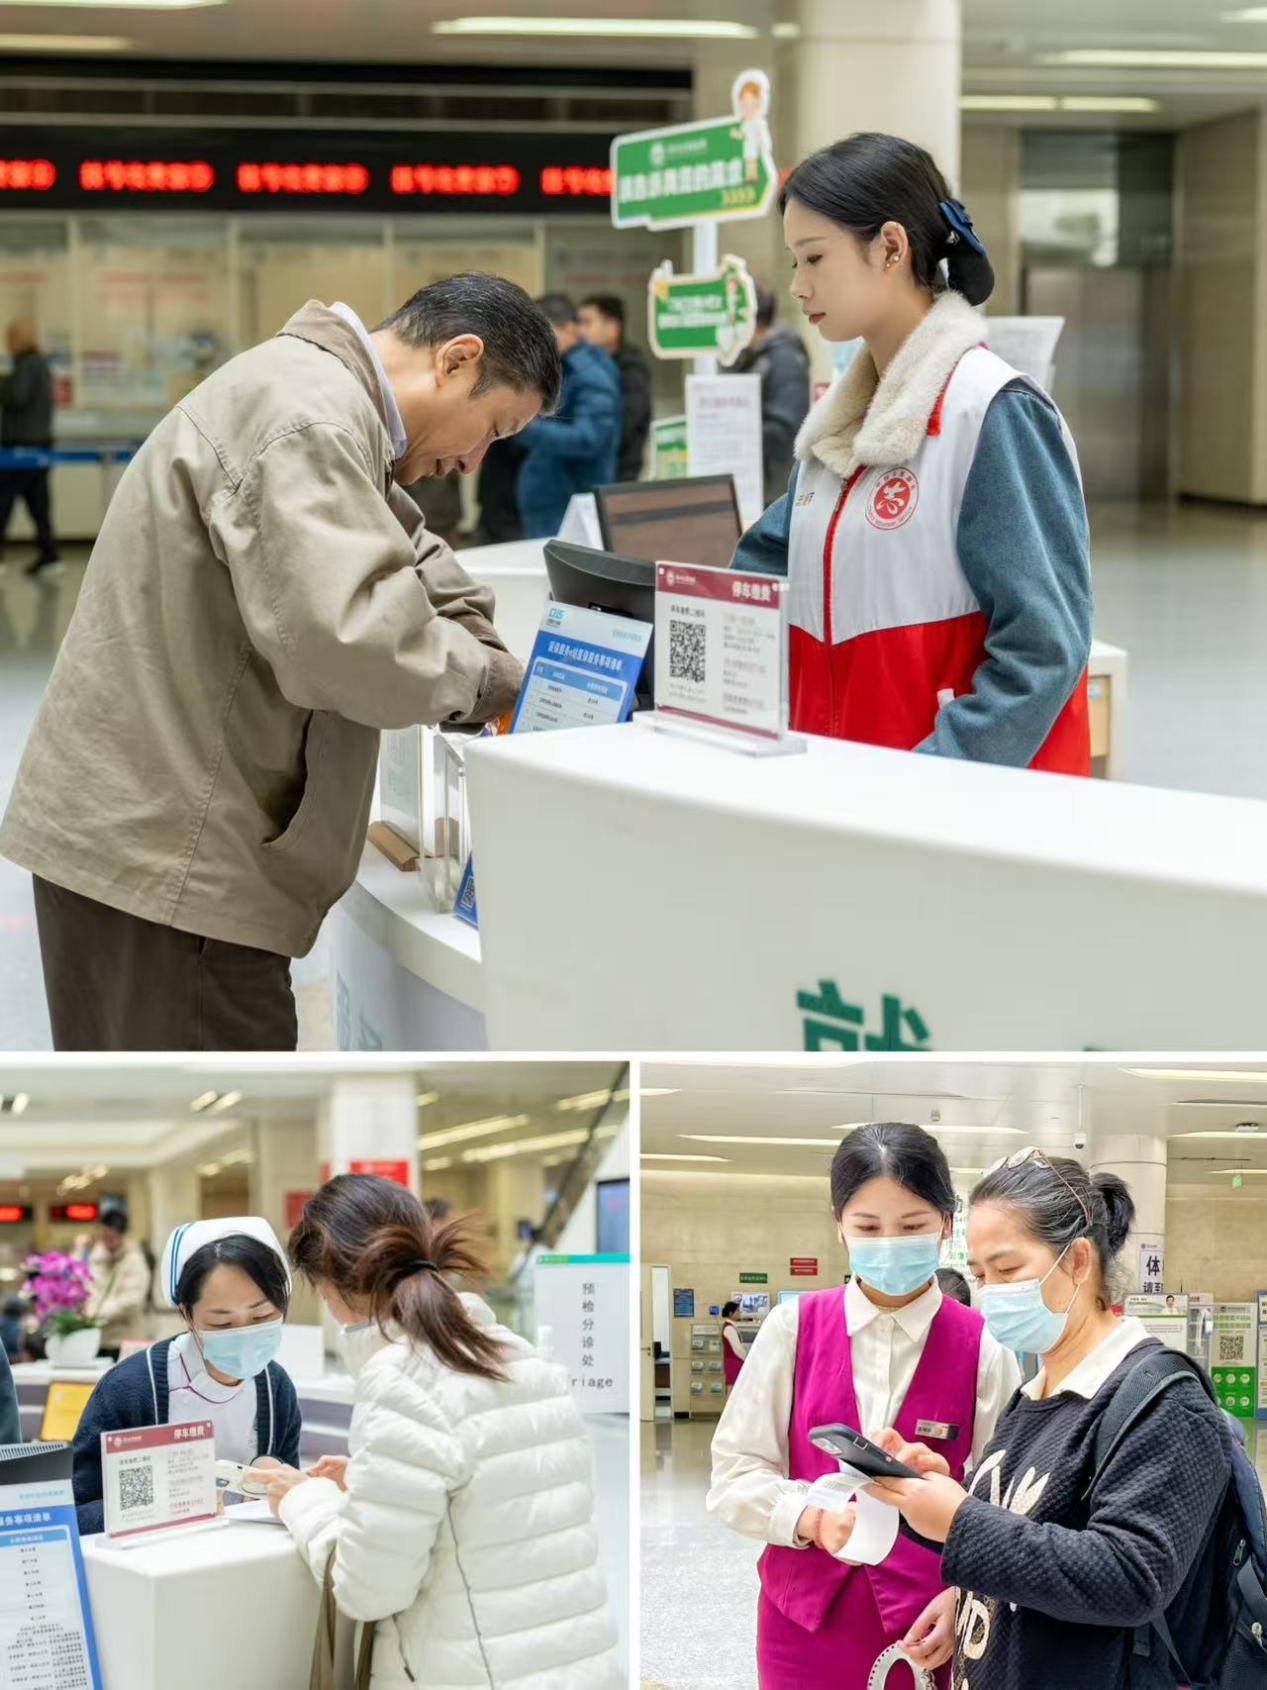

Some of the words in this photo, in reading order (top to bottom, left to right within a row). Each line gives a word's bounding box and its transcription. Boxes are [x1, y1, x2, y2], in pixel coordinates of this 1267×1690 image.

[732, 581, 772, 602] 停车缴费
[1146, 1255, 1164, 1276] 体
[1143, 1282, 1163, 1294] 请到
[582, 1283, 595, 1366] 预检分诊处
[571, 1376, 613, 1389] riage
[173, 1426, 205, 1441] 停车缴费
